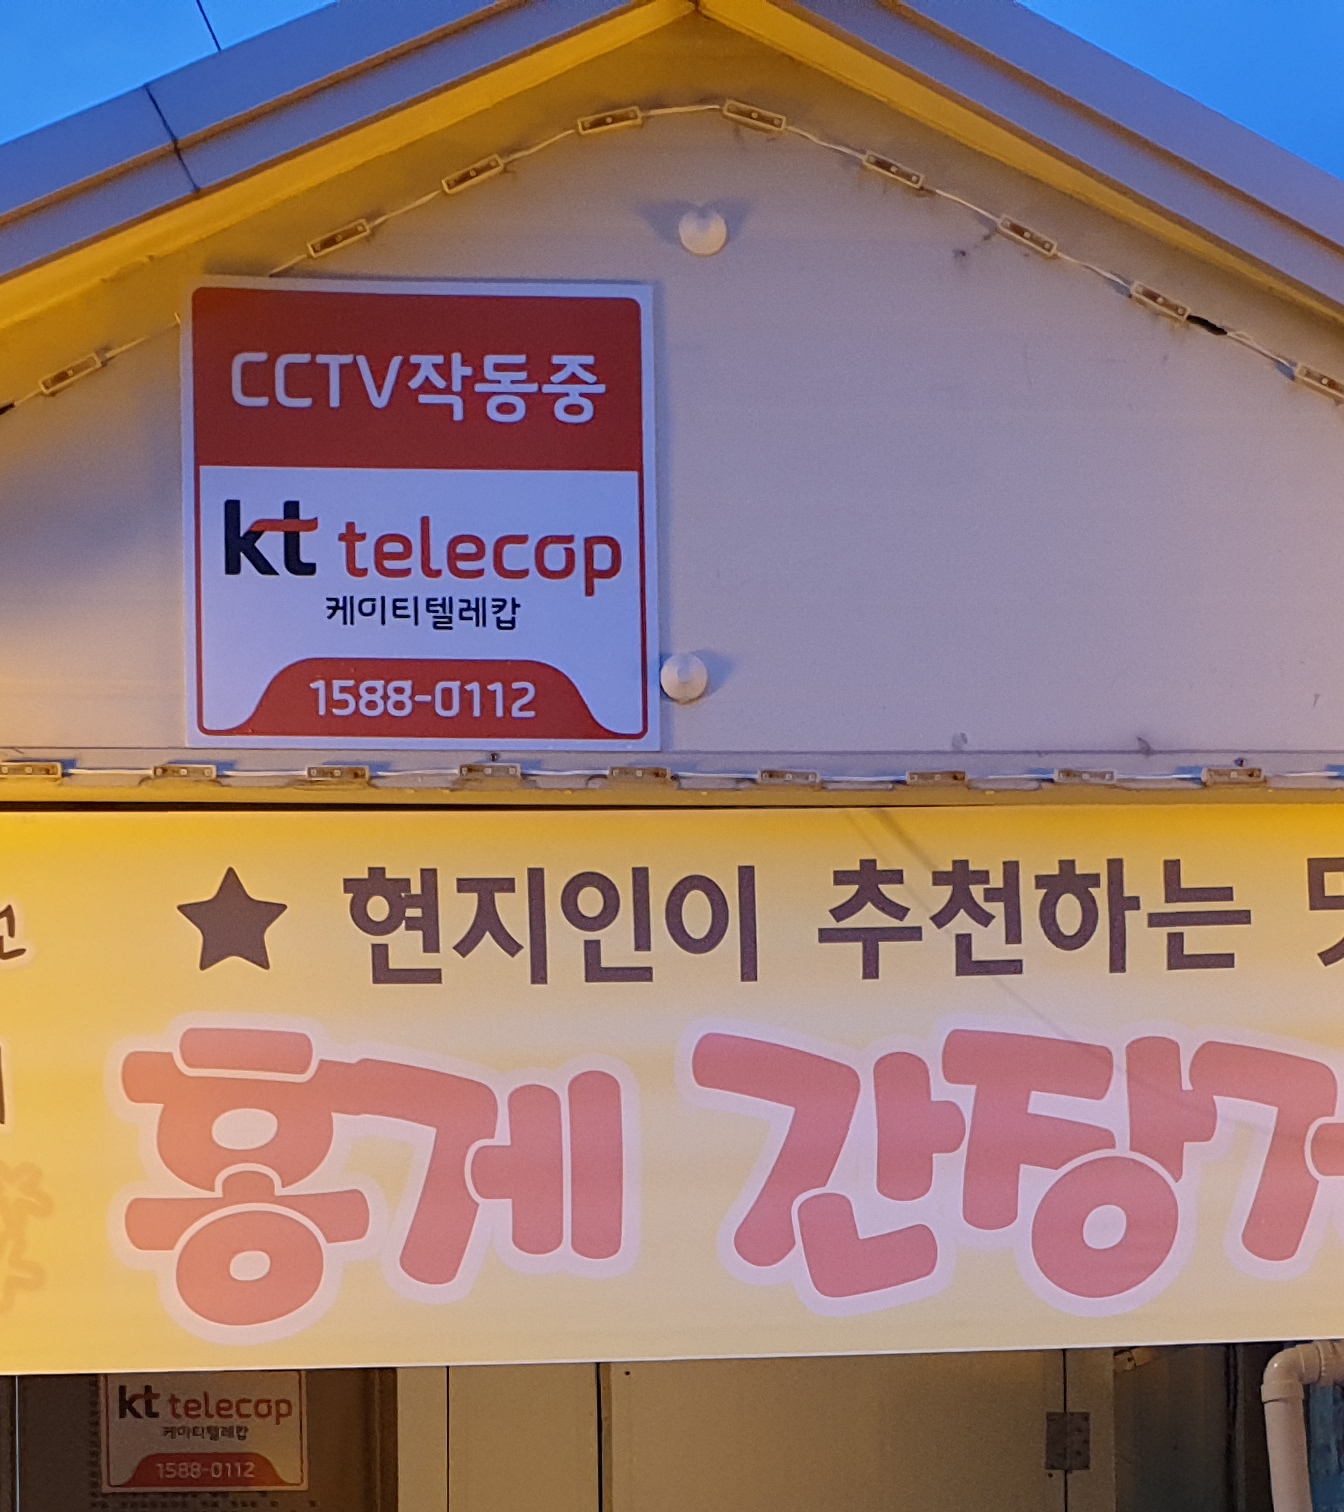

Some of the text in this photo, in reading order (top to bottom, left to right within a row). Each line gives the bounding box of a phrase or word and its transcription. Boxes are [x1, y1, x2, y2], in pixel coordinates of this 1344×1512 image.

[231, 352, 606, 424] CCTV작동중
[224, 499, 622, 597] kt telecop
[326, 596, 521, 630] 케이티텔레캅
[310, 680, 536, 719] 1588-0112
[343, 865, 758, 985] 현지인이
[818, 857, 1252, 980] 추천하는
[121, 1027, 623, 1327] 홍게
[118, 1385, 292, 1425] kt telecop
[156, 1462, 255, 1479] 1588-0112
